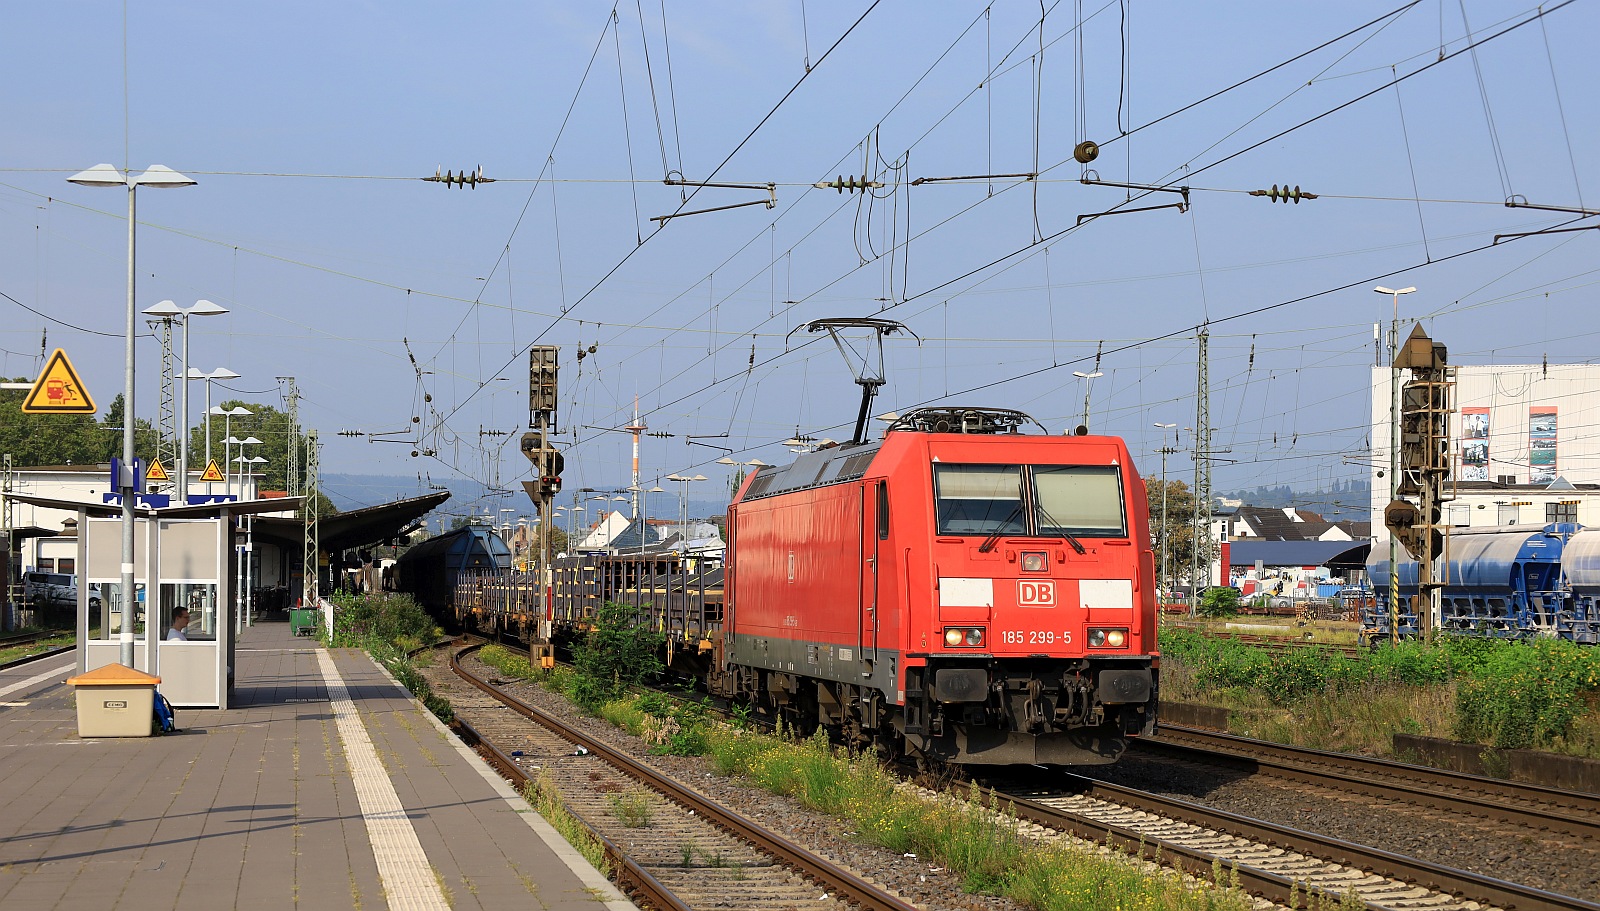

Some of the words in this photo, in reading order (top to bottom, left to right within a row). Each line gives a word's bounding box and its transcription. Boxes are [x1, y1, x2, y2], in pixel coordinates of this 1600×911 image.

[1021, 583, 1052, 603] DB
[1001, 630, 1025, 644] 185
[1029, 630, 1072, 644] 299-5
